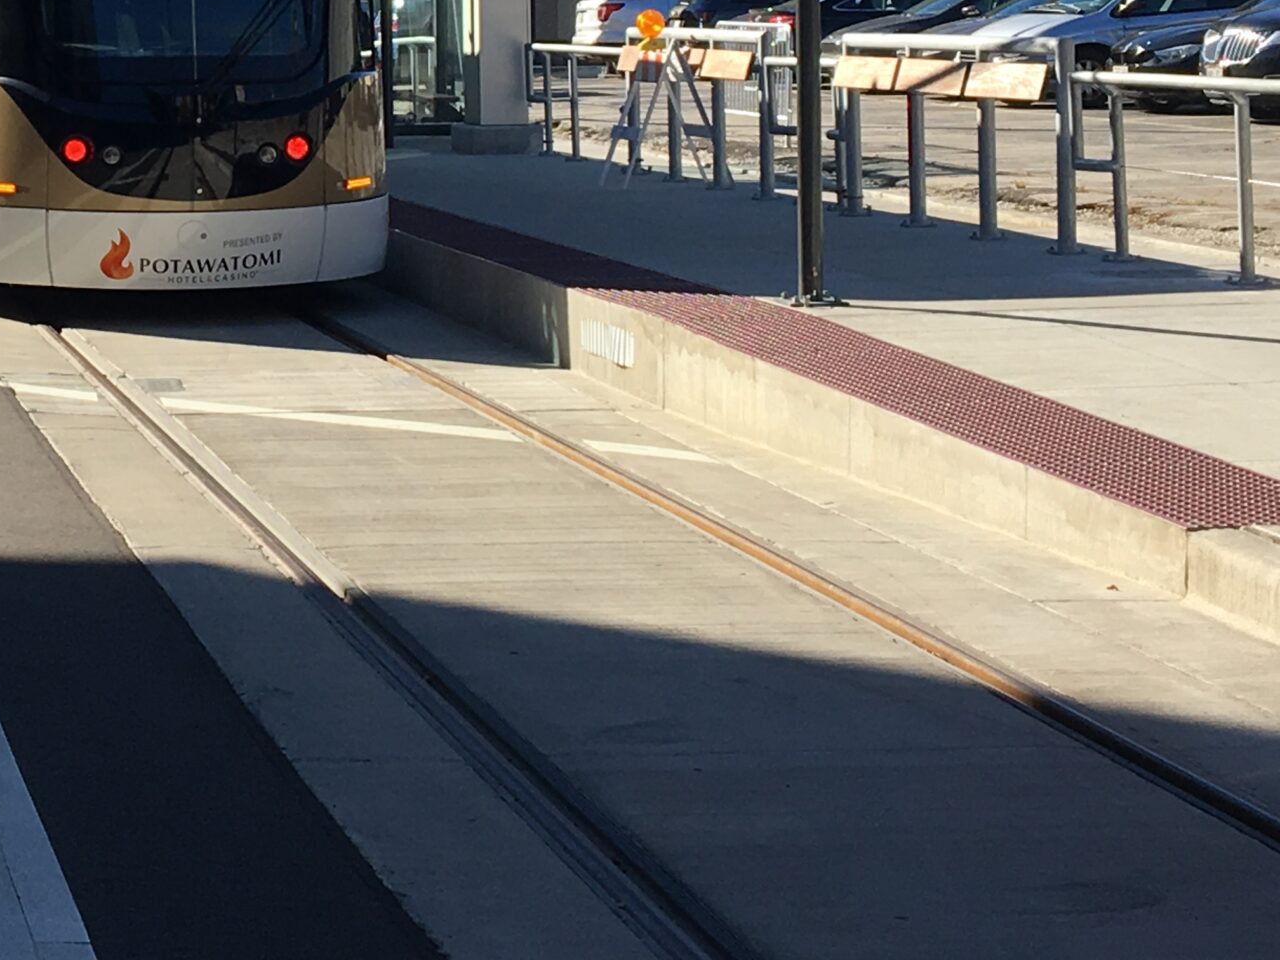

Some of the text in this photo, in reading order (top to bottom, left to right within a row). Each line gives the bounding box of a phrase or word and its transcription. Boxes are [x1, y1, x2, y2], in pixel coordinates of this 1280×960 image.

[223, 232, 283, 248] PRESENTED BY
[139, 249, 281, 274] POTAWATOMI
